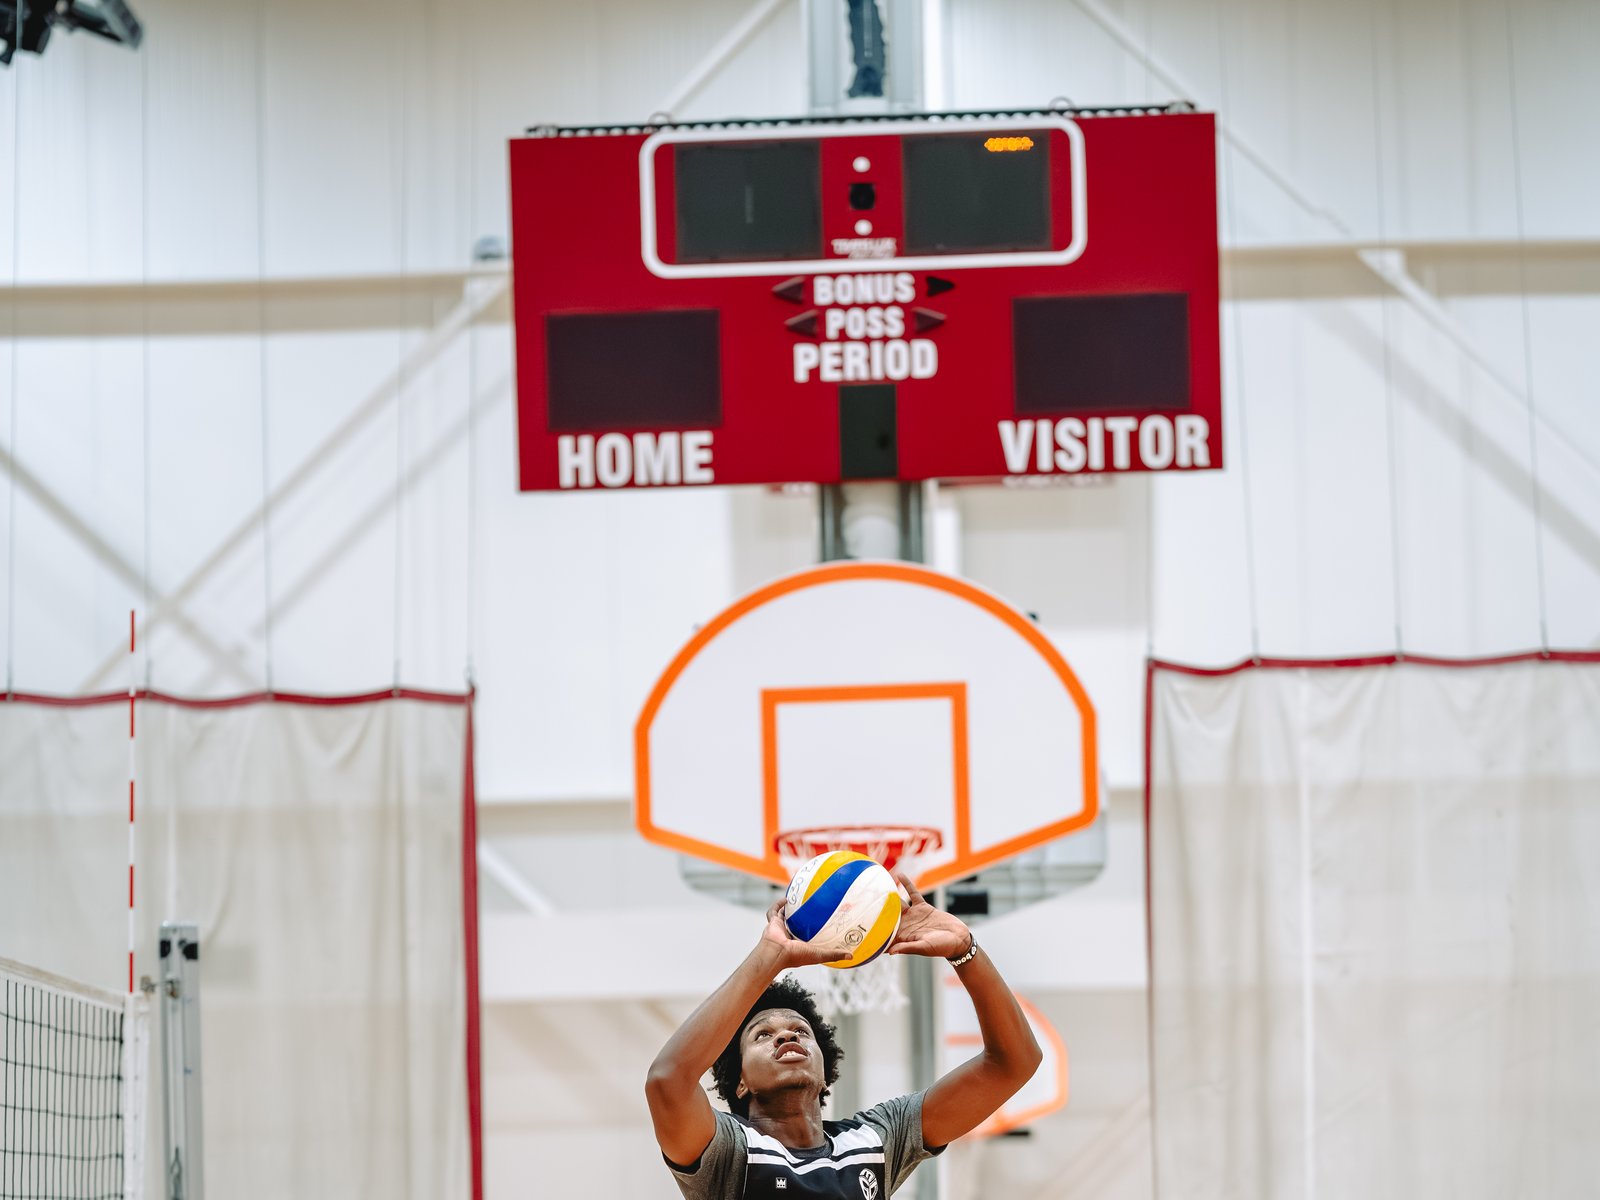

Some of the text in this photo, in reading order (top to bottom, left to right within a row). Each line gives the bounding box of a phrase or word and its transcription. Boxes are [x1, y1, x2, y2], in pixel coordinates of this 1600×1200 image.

[813, 272, 916, 306] BONUS
[825, 305, 905, 340] POSS
[793, 338, 938, 383] PERIOD
[558, 430, 715, 488] HOME
[998, 414, 1211, 473] VISITOR
